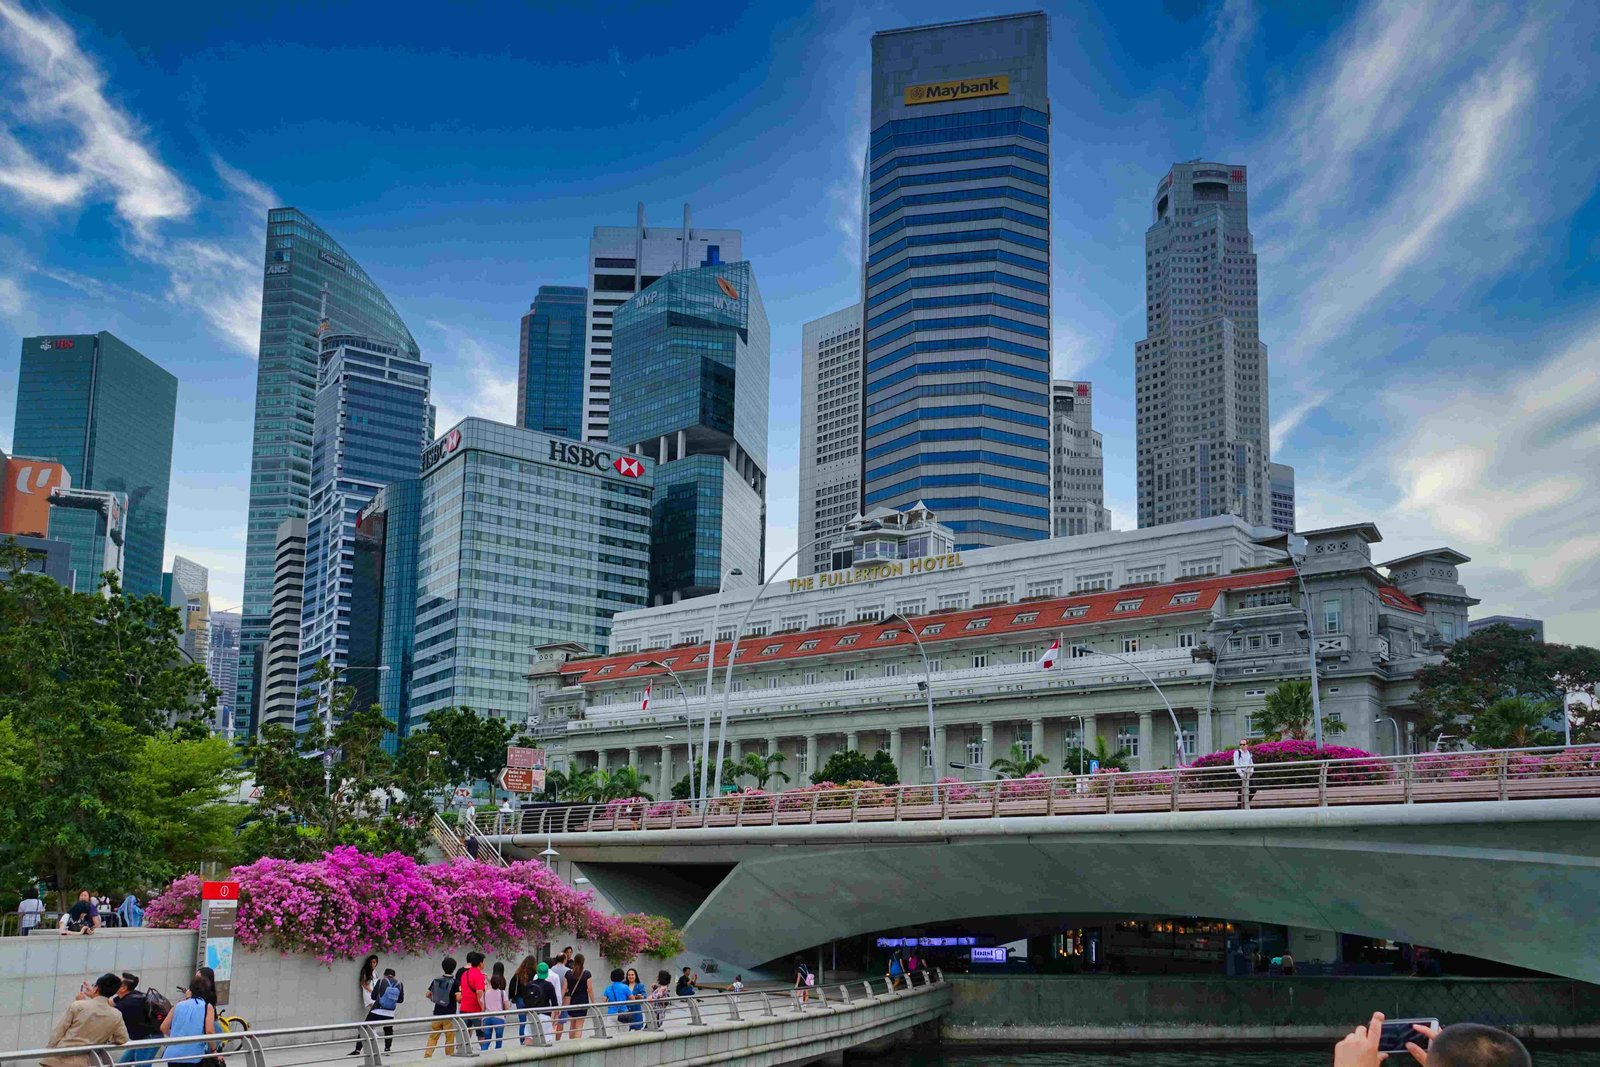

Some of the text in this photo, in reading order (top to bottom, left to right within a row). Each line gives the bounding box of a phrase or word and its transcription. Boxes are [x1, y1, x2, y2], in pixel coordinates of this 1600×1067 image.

[926, 79, 999, 98] Maybank
[321, 252, 345, 270] Keppel
[636, 290, 658, 309] MYP
[713, 295, 741, 312] MYP
[549, 439, 611, 472] HSBC
[787, 552, 963, 593] THE FULLERTON HOTEL
